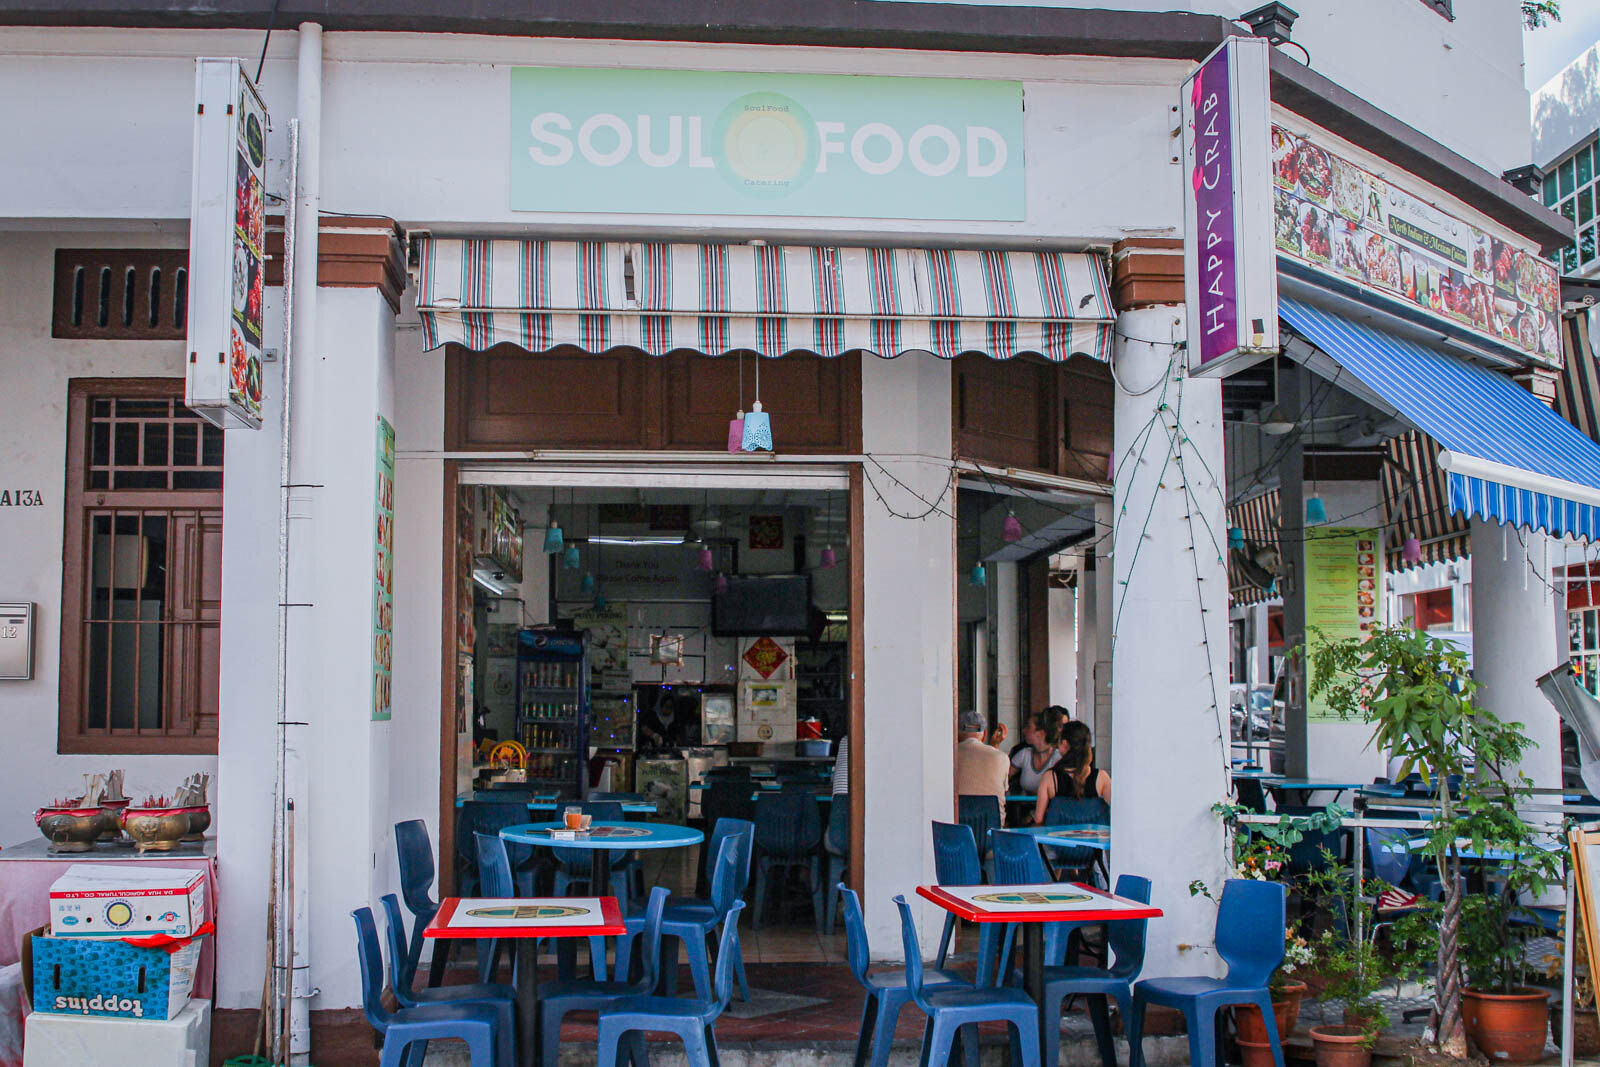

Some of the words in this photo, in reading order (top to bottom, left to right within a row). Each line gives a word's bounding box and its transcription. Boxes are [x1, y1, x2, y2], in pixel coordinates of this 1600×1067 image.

[527, 112, 715, 168] SOUL
[815, 121, 1008, 177] FOOD
[1203, 92, 1220, 190] CRAB
[744, 179, 790, 188] Catering
[1391, 217, 1408, 235] North
[1206, 210, 1225, 335] HAPPY
[625, 573, 651, 584] Come
[1, 626, 17, 639] 12
[55, 994, 143, 1017] toppins
